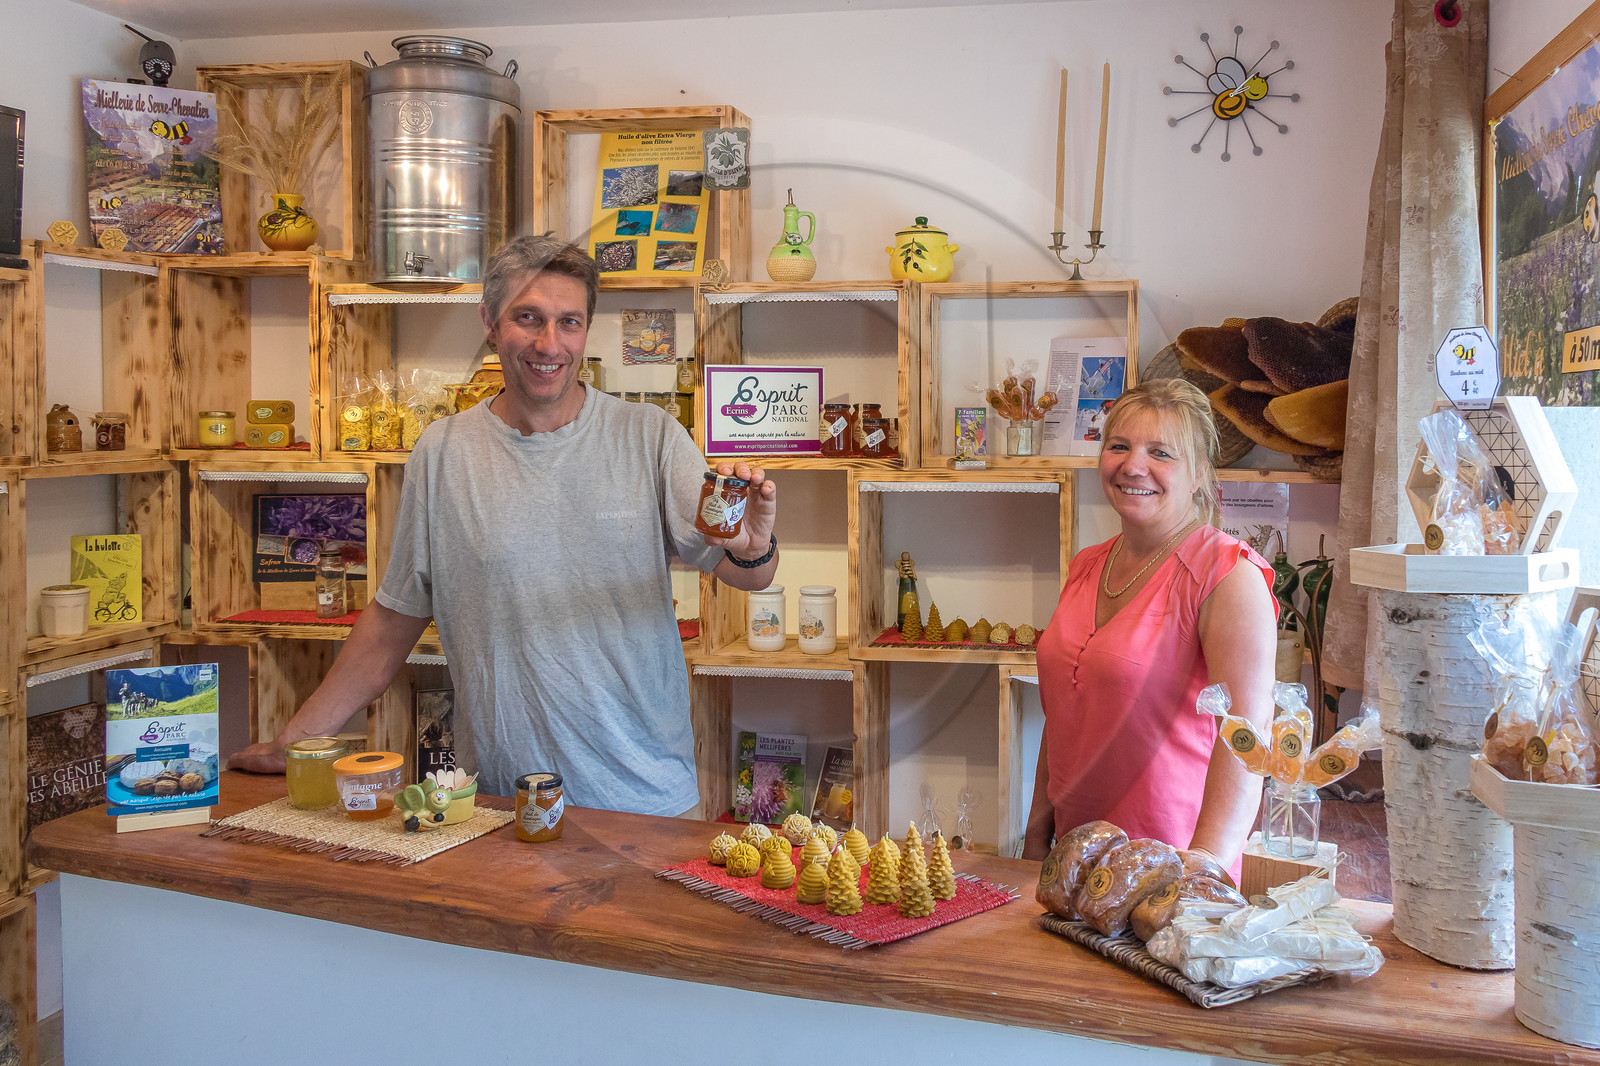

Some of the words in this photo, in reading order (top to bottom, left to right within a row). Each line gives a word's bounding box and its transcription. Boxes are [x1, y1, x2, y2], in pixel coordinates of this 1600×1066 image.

[95, 89, 134, 111] Miellerie
[135, 93, 146, 112] de
[148, 94, 210, 119] Serre-Chevalier
[626, 312, 640, 322] LE
[1570, 336, 1577, 363] à
[1462, 380, 1469, 396] 4
[730, 376, 808, 426] Esprit
[772, 405, 808, 415] PARC
[85, 539, 93, 551] la
[95, 538, 120, 551] hulotte
[144, 721, 186, 744] Esprit
[430, 751, 455, 764] LES
[32, 775, 48, 789] LE
[54, 760, 102, 782] GÉNIE
[26, 789, 45, 804] ES
